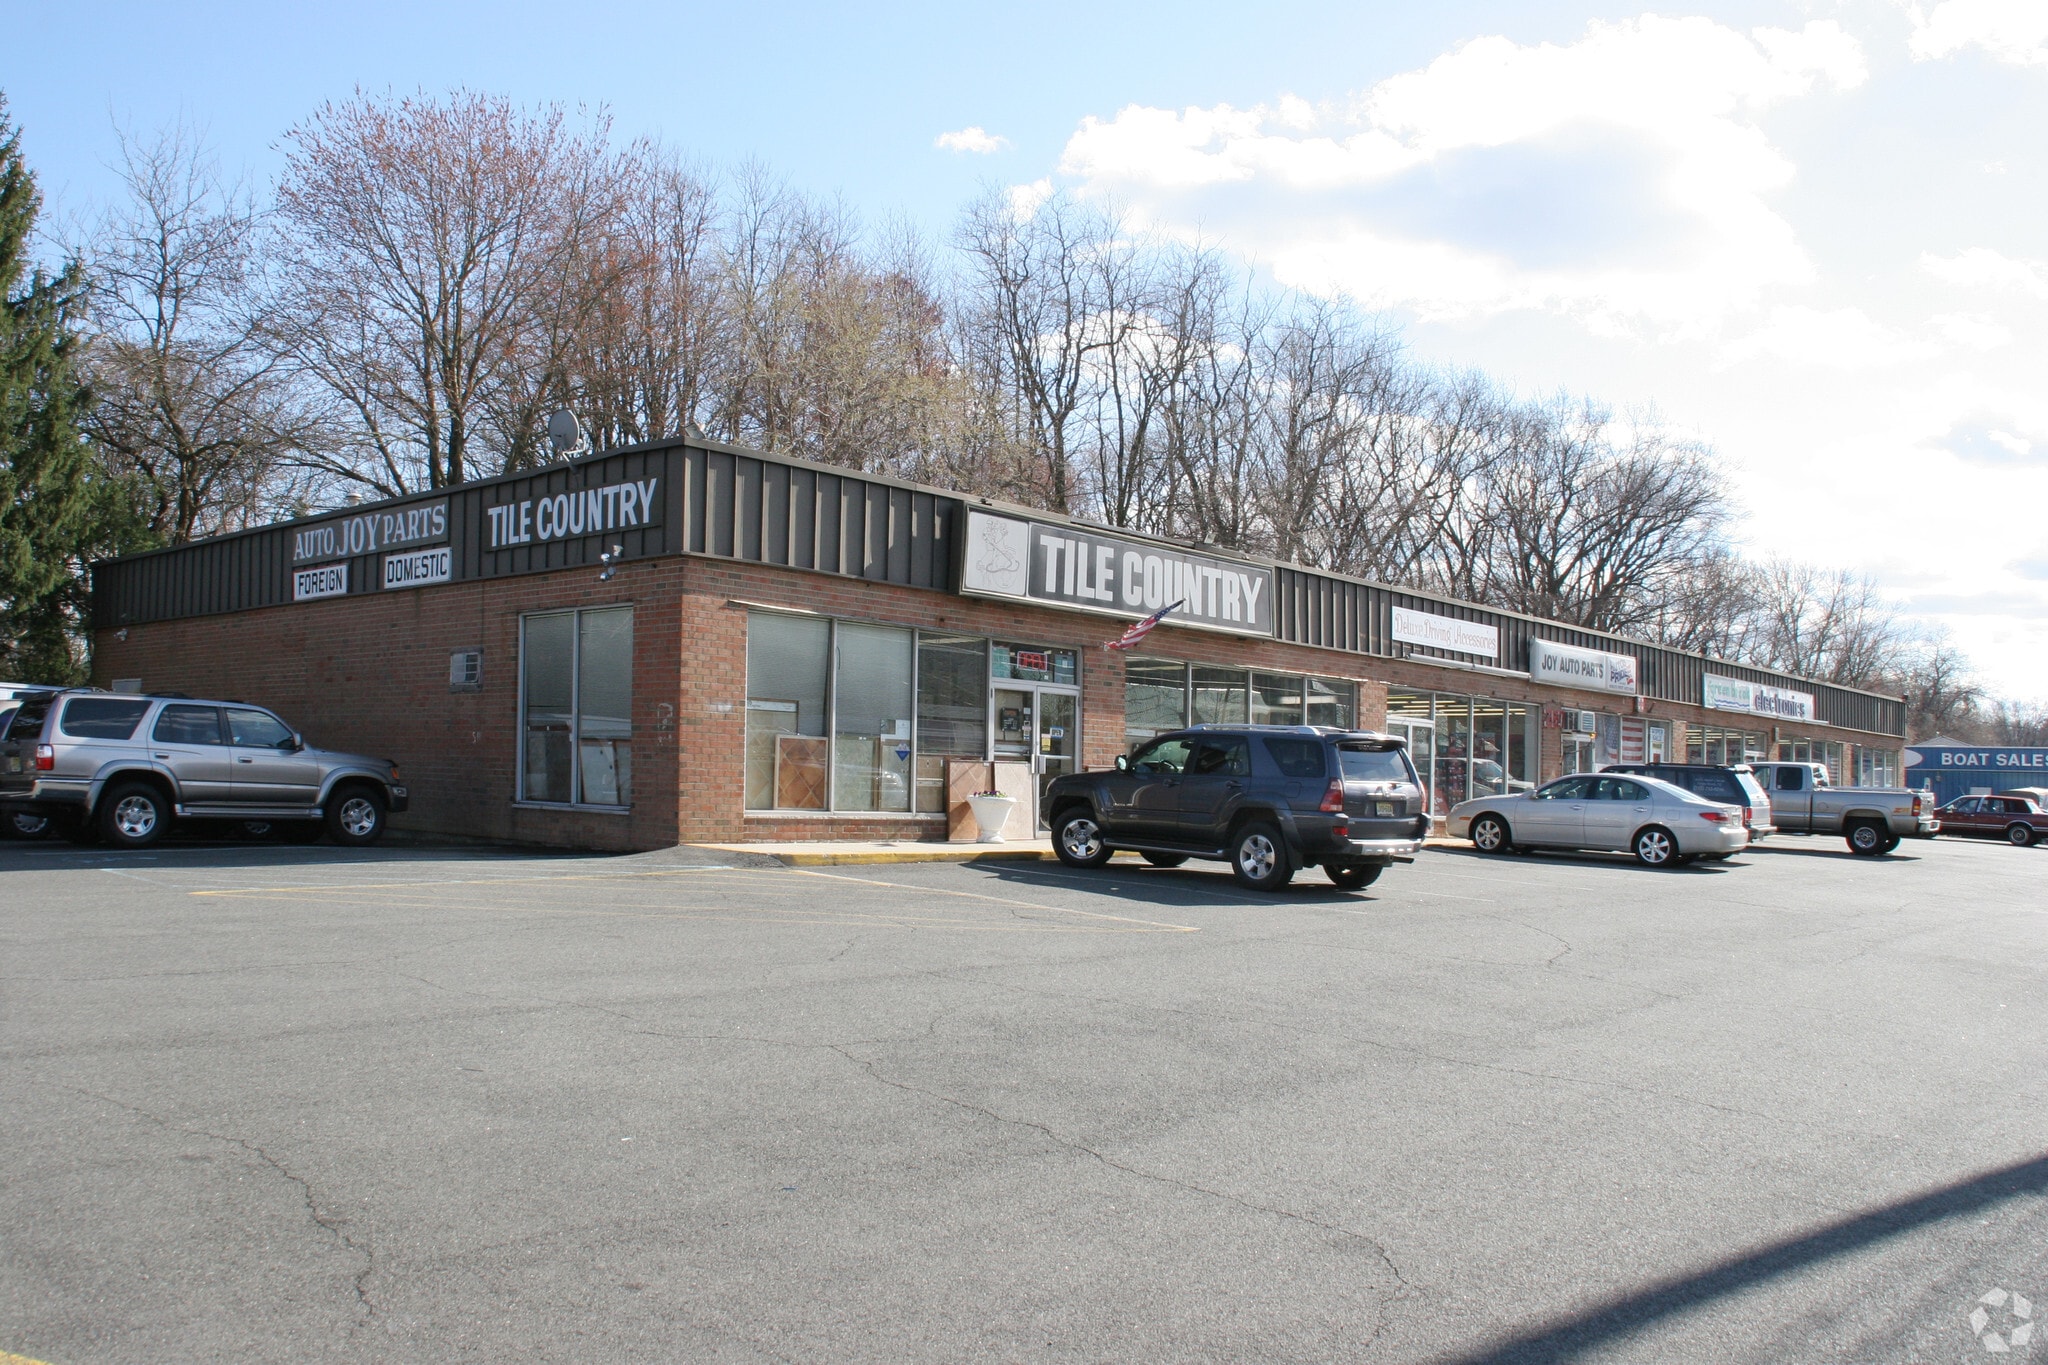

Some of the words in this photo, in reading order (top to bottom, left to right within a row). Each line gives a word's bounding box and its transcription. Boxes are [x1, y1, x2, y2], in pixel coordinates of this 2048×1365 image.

[488, 499, 532, 548] TILE
[536, 478, 658, 541] COUNTRY
[293, 526, 334, 561] AUTO
[336, 513, 381, 557] JOY
[383, 504, 446, 545] PARTS
[298, 567, 344, 596] FOREIGN
[386, 553, 448, 584] DOMESTIC
[1039, 534, 1114, 602] TILE
[1122, 551, 1263, 624] COUNTRY
[1395, 613, 1423, 637] Deluxe
[1424, 618, 1452, 646] Driving
[1454, 626, 1496, 651] Accessories
[1541, 654, 1558, 671] JOY
[1559, 659, 1580, 675] AUTO
[1581, 662, 1604, 679] PARTS
[1754, 689, 1805, 717] electronics
[1941, 752, 1990, 766] BOAT
[1996, 753, 2048, 767] SALE
